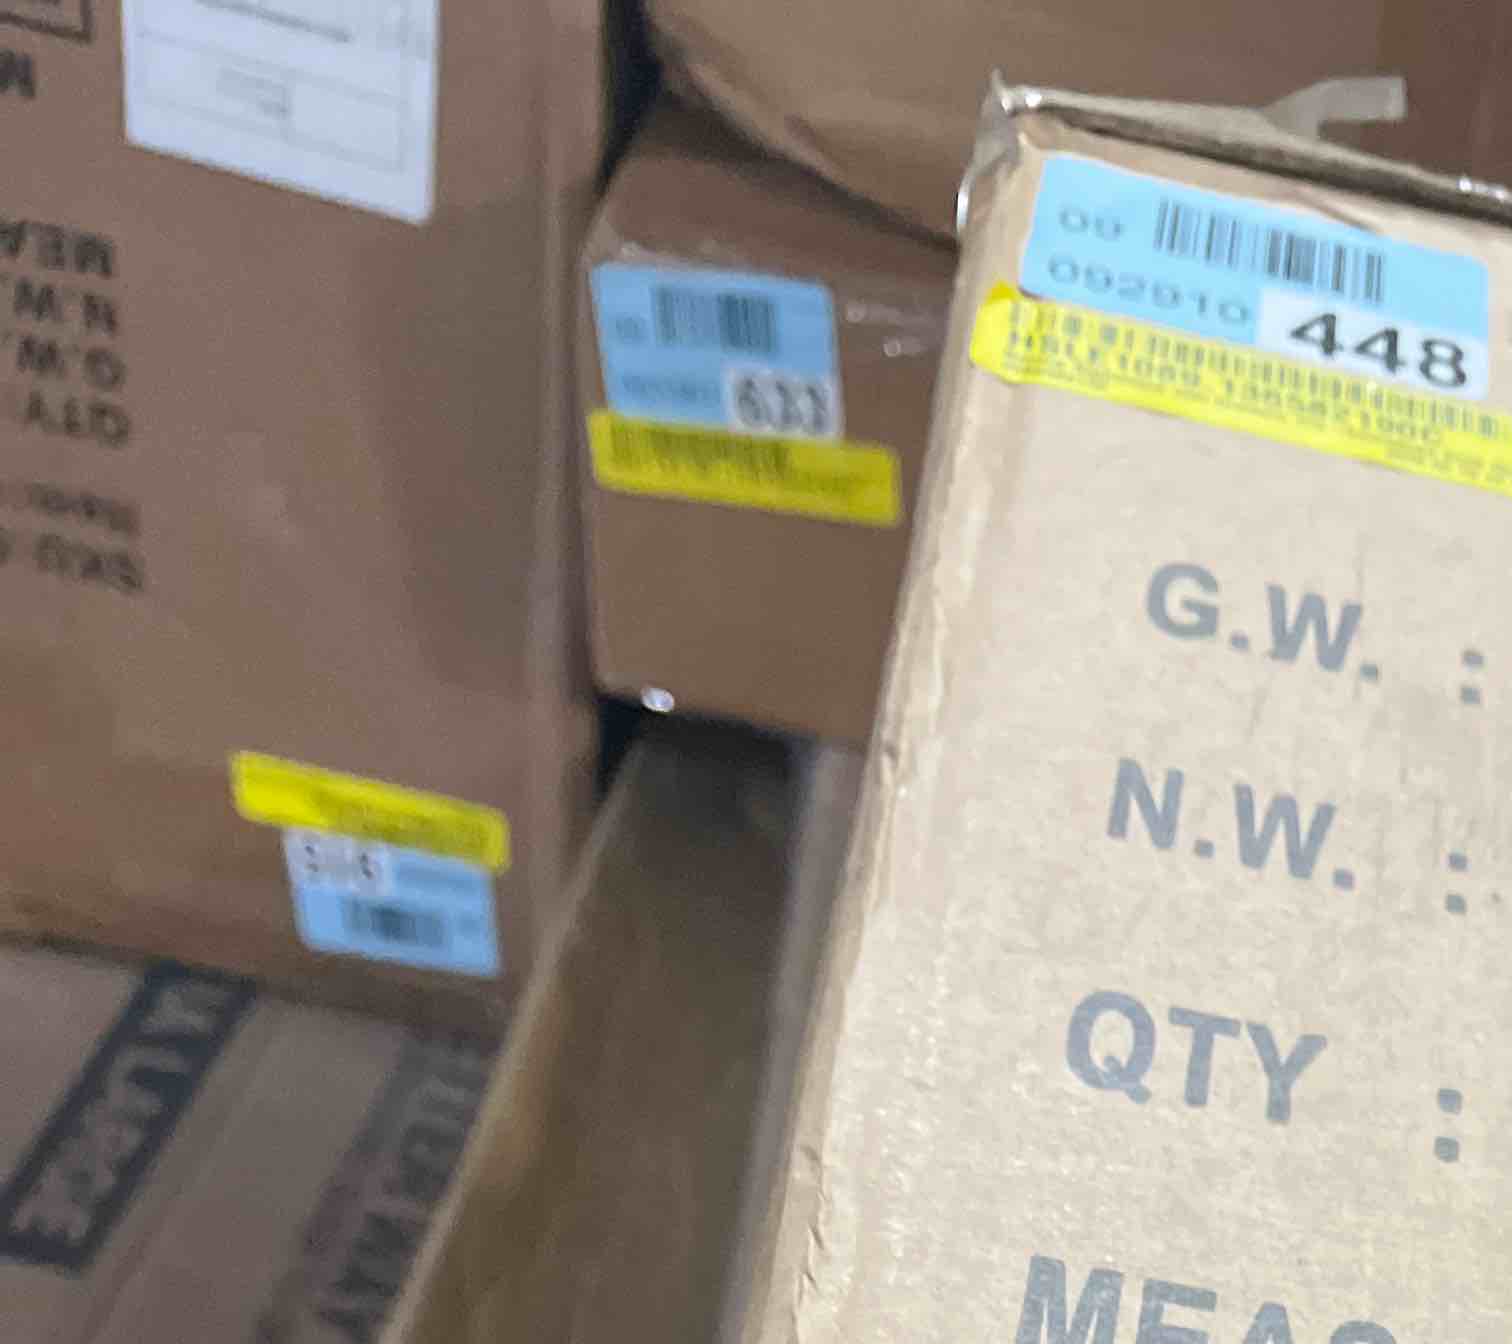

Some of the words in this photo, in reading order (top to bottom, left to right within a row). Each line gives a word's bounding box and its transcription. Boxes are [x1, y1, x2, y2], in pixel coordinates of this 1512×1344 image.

[1290, 313, 1468, 387] 448
[1146, 563, 1382, 684] G.W.
[1107, 757, 1357, 891] N.W.
[1066, 989, 1330, 1126] QTY
